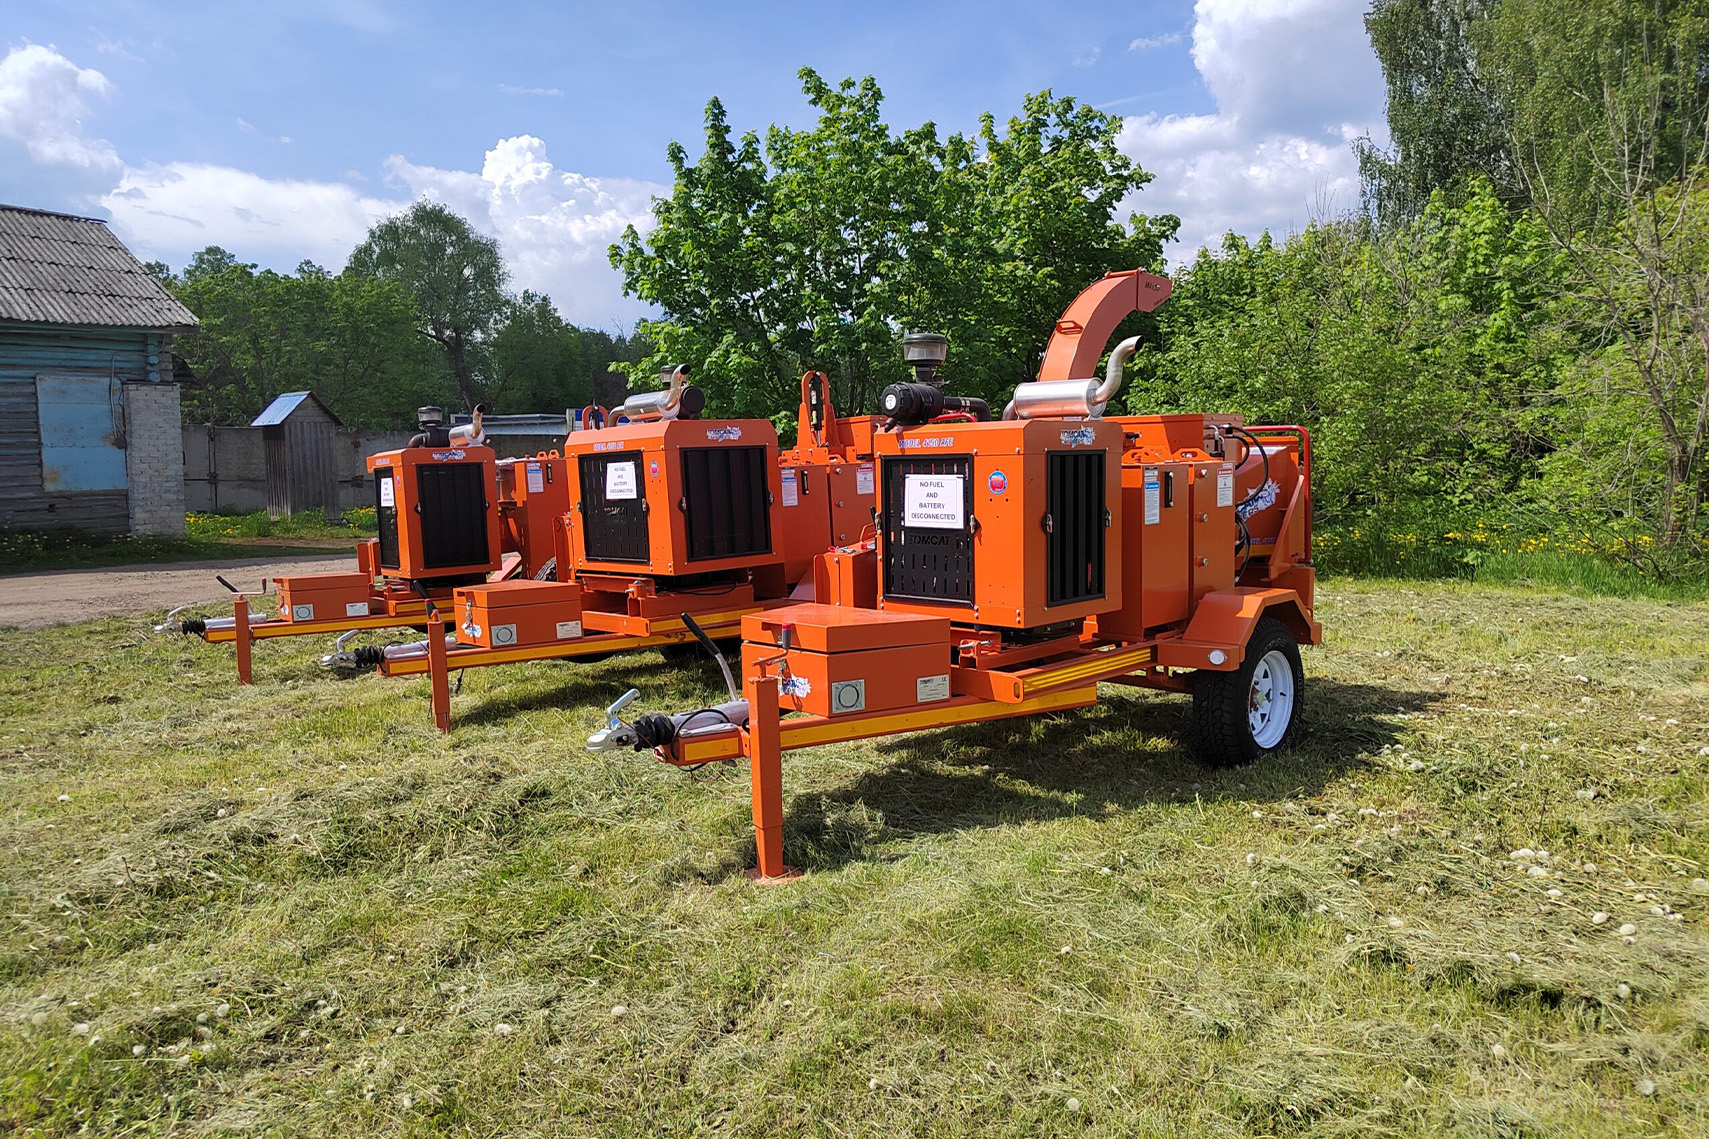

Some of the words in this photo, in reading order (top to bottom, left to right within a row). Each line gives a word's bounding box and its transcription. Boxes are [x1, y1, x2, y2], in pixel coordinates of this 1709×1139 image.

[918, 502, 945, 510] BATTERY
[911, 512, 956, 521] DISCONNECTED
[908, 534, 951, 546] TOMCAT
